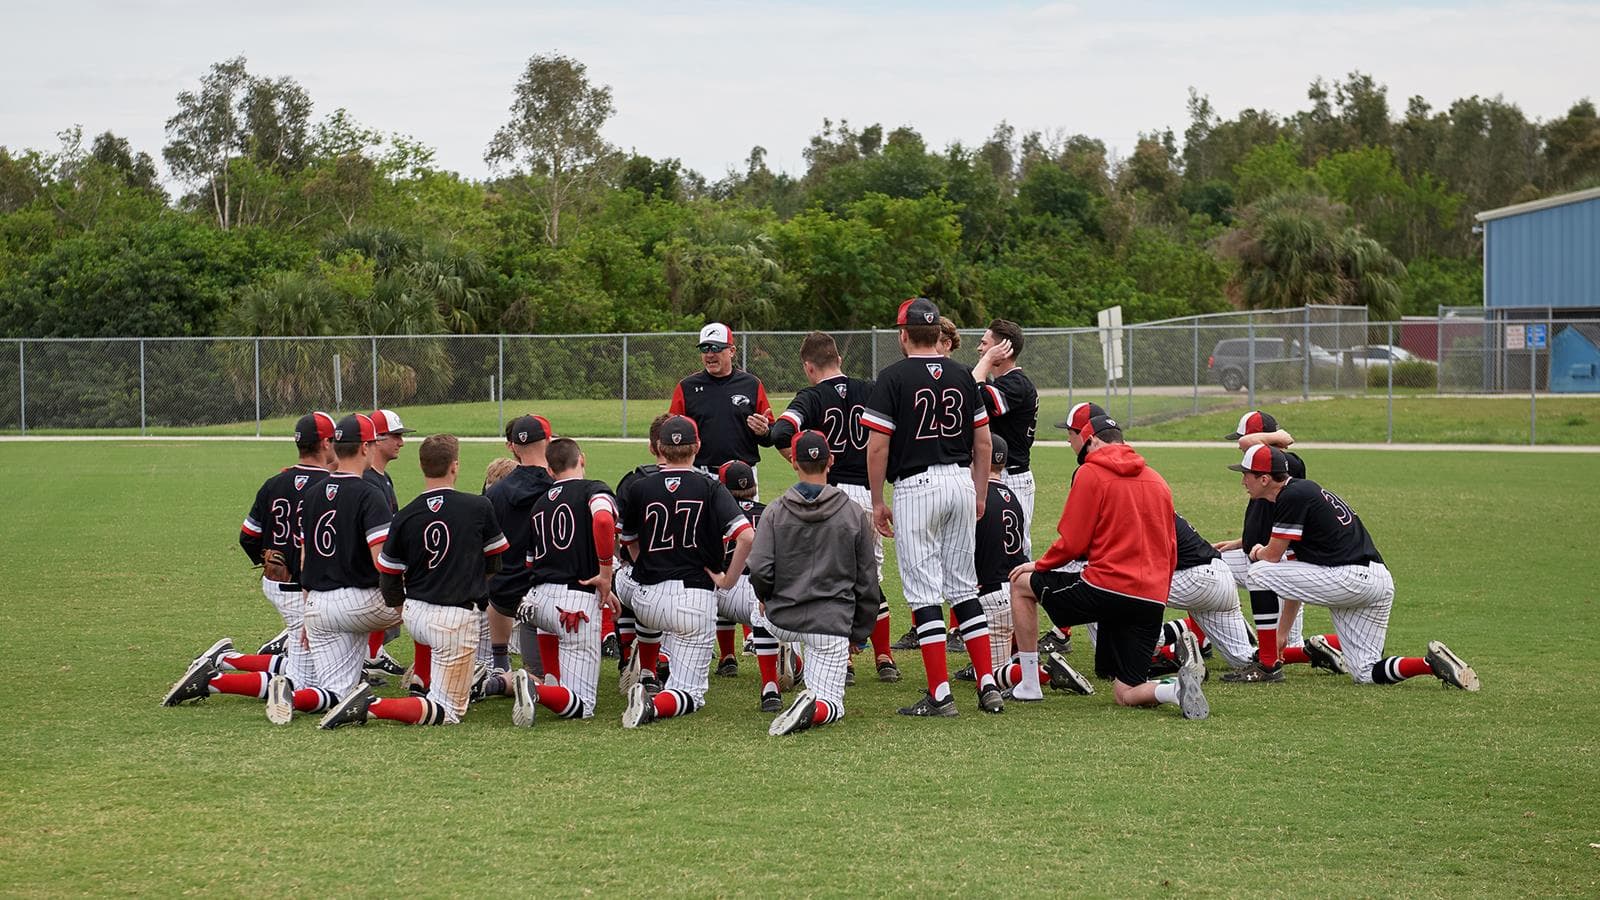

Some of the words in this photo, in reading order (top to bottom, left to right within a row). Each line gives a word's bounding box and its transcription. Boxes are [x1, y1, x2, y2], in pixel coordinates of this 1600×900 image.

[823, 404, 870, 453] 20
[914, 387, 964, 440] 23
[533, 503, 575, 560] 10
[645, 499, 704, 552] 27
[1002, 509, 1022, 555] 3
[1320, 488, 1357, 527] 3
[314, 509, 337, 557] 6
[424, 520, 450, 569] 9
